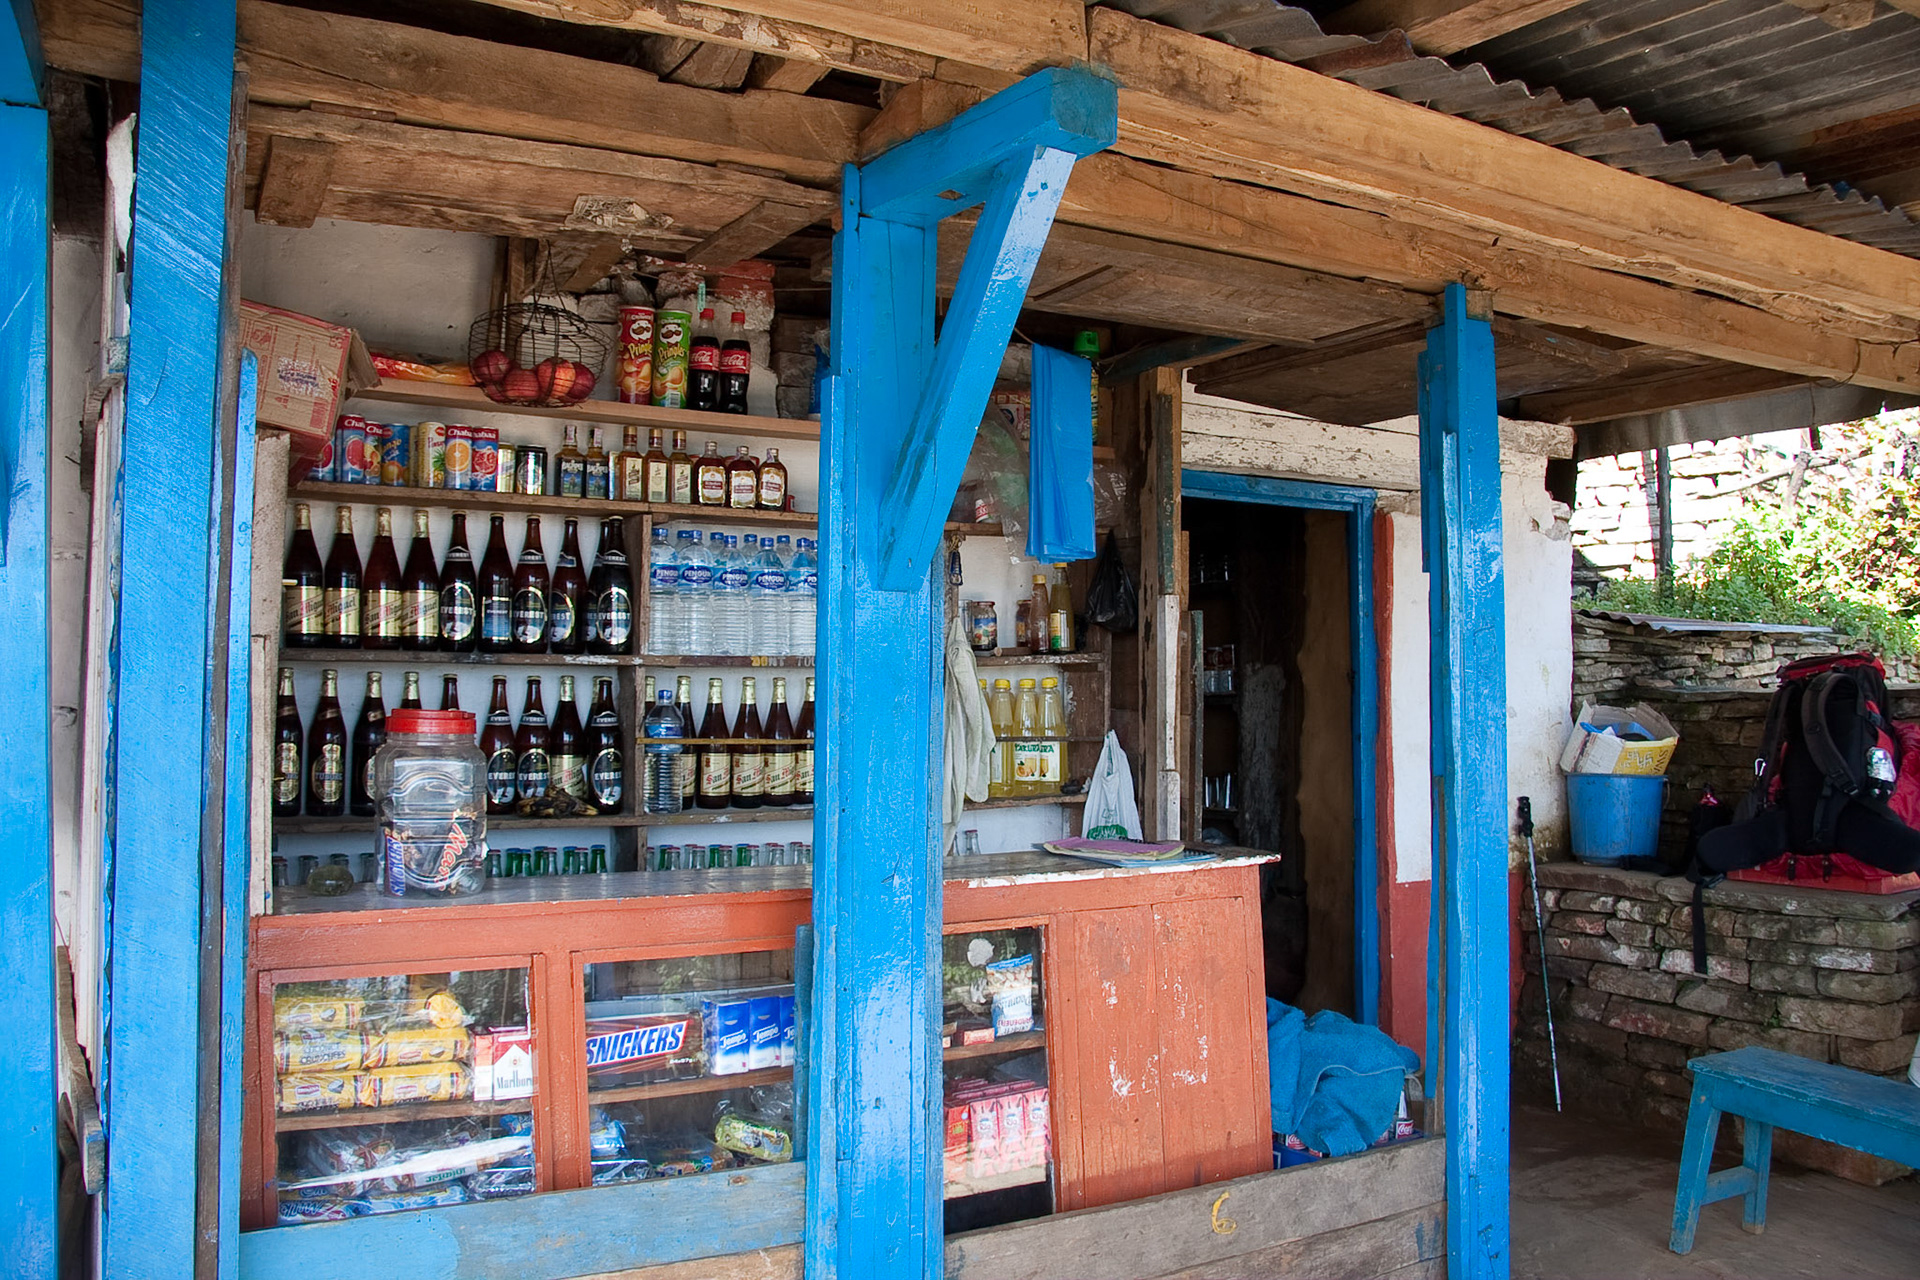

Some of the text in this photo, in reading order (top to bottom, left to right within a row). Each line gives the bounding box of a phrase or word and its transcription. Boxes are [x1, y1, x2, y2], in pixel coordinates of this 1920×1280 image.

[656, 569, 678, 577] PENGU
[441, 606, 473, 614] EVEREST
[599, 611, 630, 620] EVEREST
[720, 1030, 747, 1049] Tempo
[753, 1023, 780, 1043] Tempo
[587, 1023, 684, 1065] SNICKERS
[497, 1070, 532, 1089] Marlbor
[1212, 1191, 1237, 1235] 6
